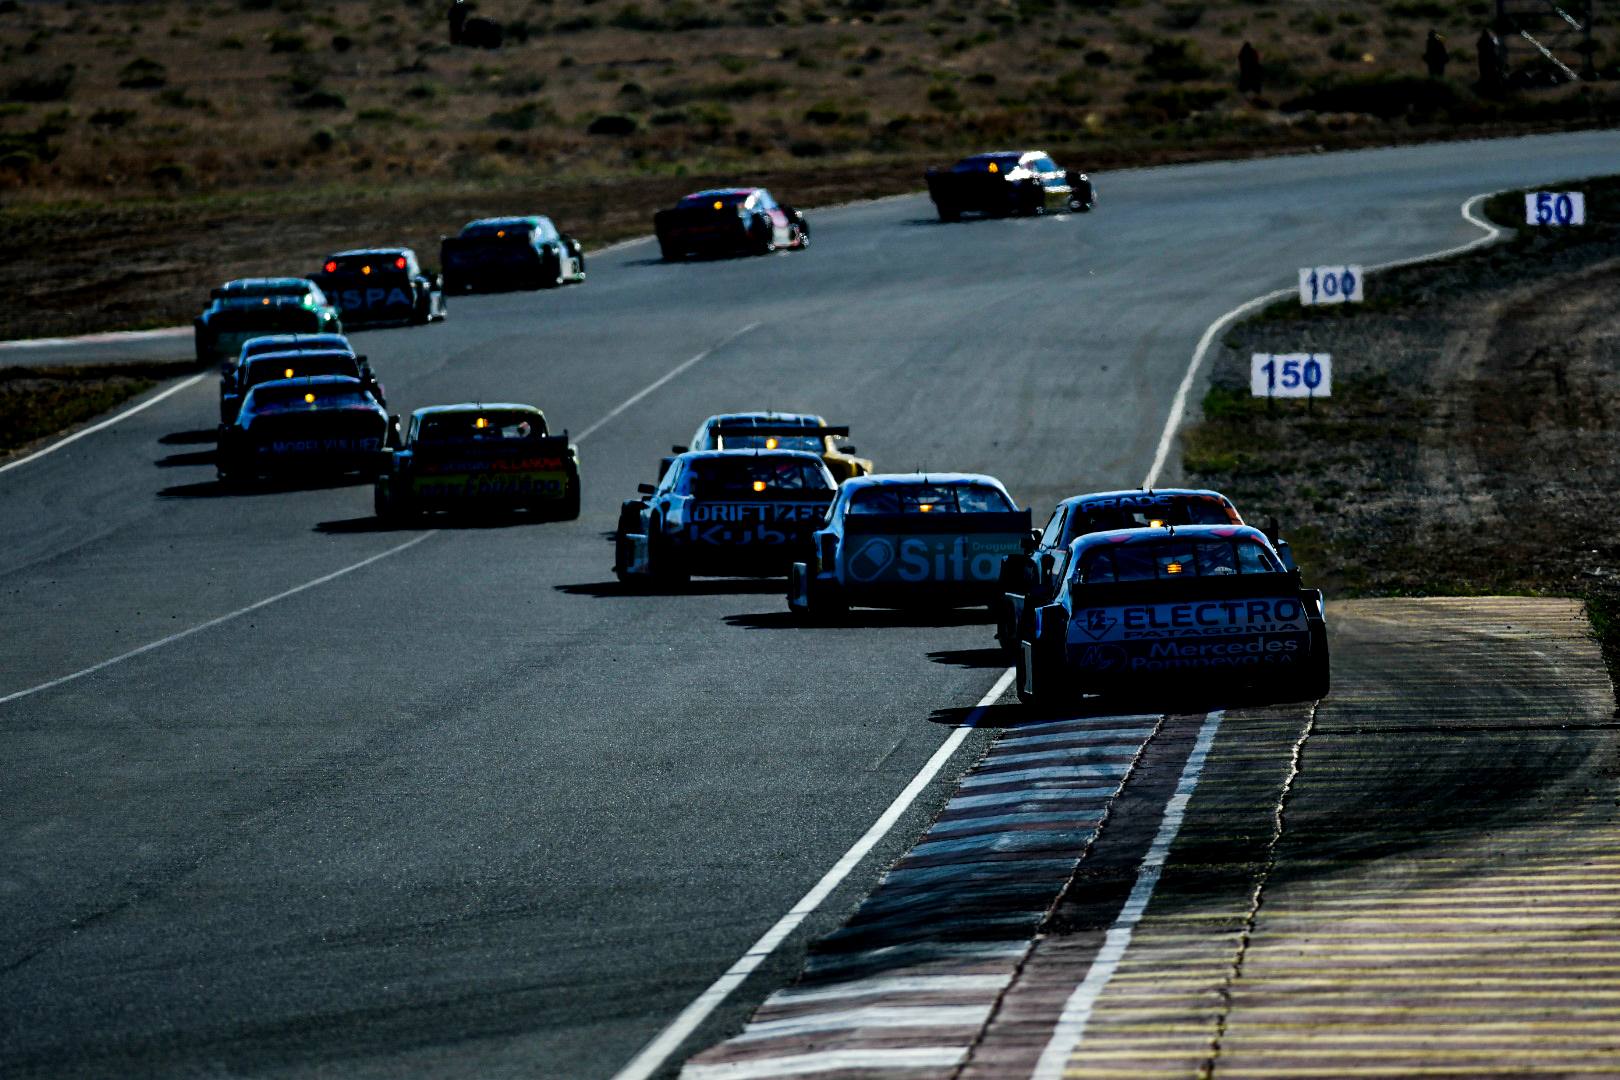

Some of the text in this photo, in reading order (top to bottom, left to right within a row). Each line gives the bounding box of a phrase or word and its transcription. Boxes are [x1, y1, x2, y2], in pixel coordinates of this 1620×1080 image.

[1535, 192, 1574, 226] 50
[1308, 271, 1356, 296] 100
[1261, 360, 1322, 388] 150
[1124, 600, 1300, 630] ELECTRO
[1124, 623, 1300, 639] PATAGONIA
[1150, 637, 1298, 658] Mercedes
